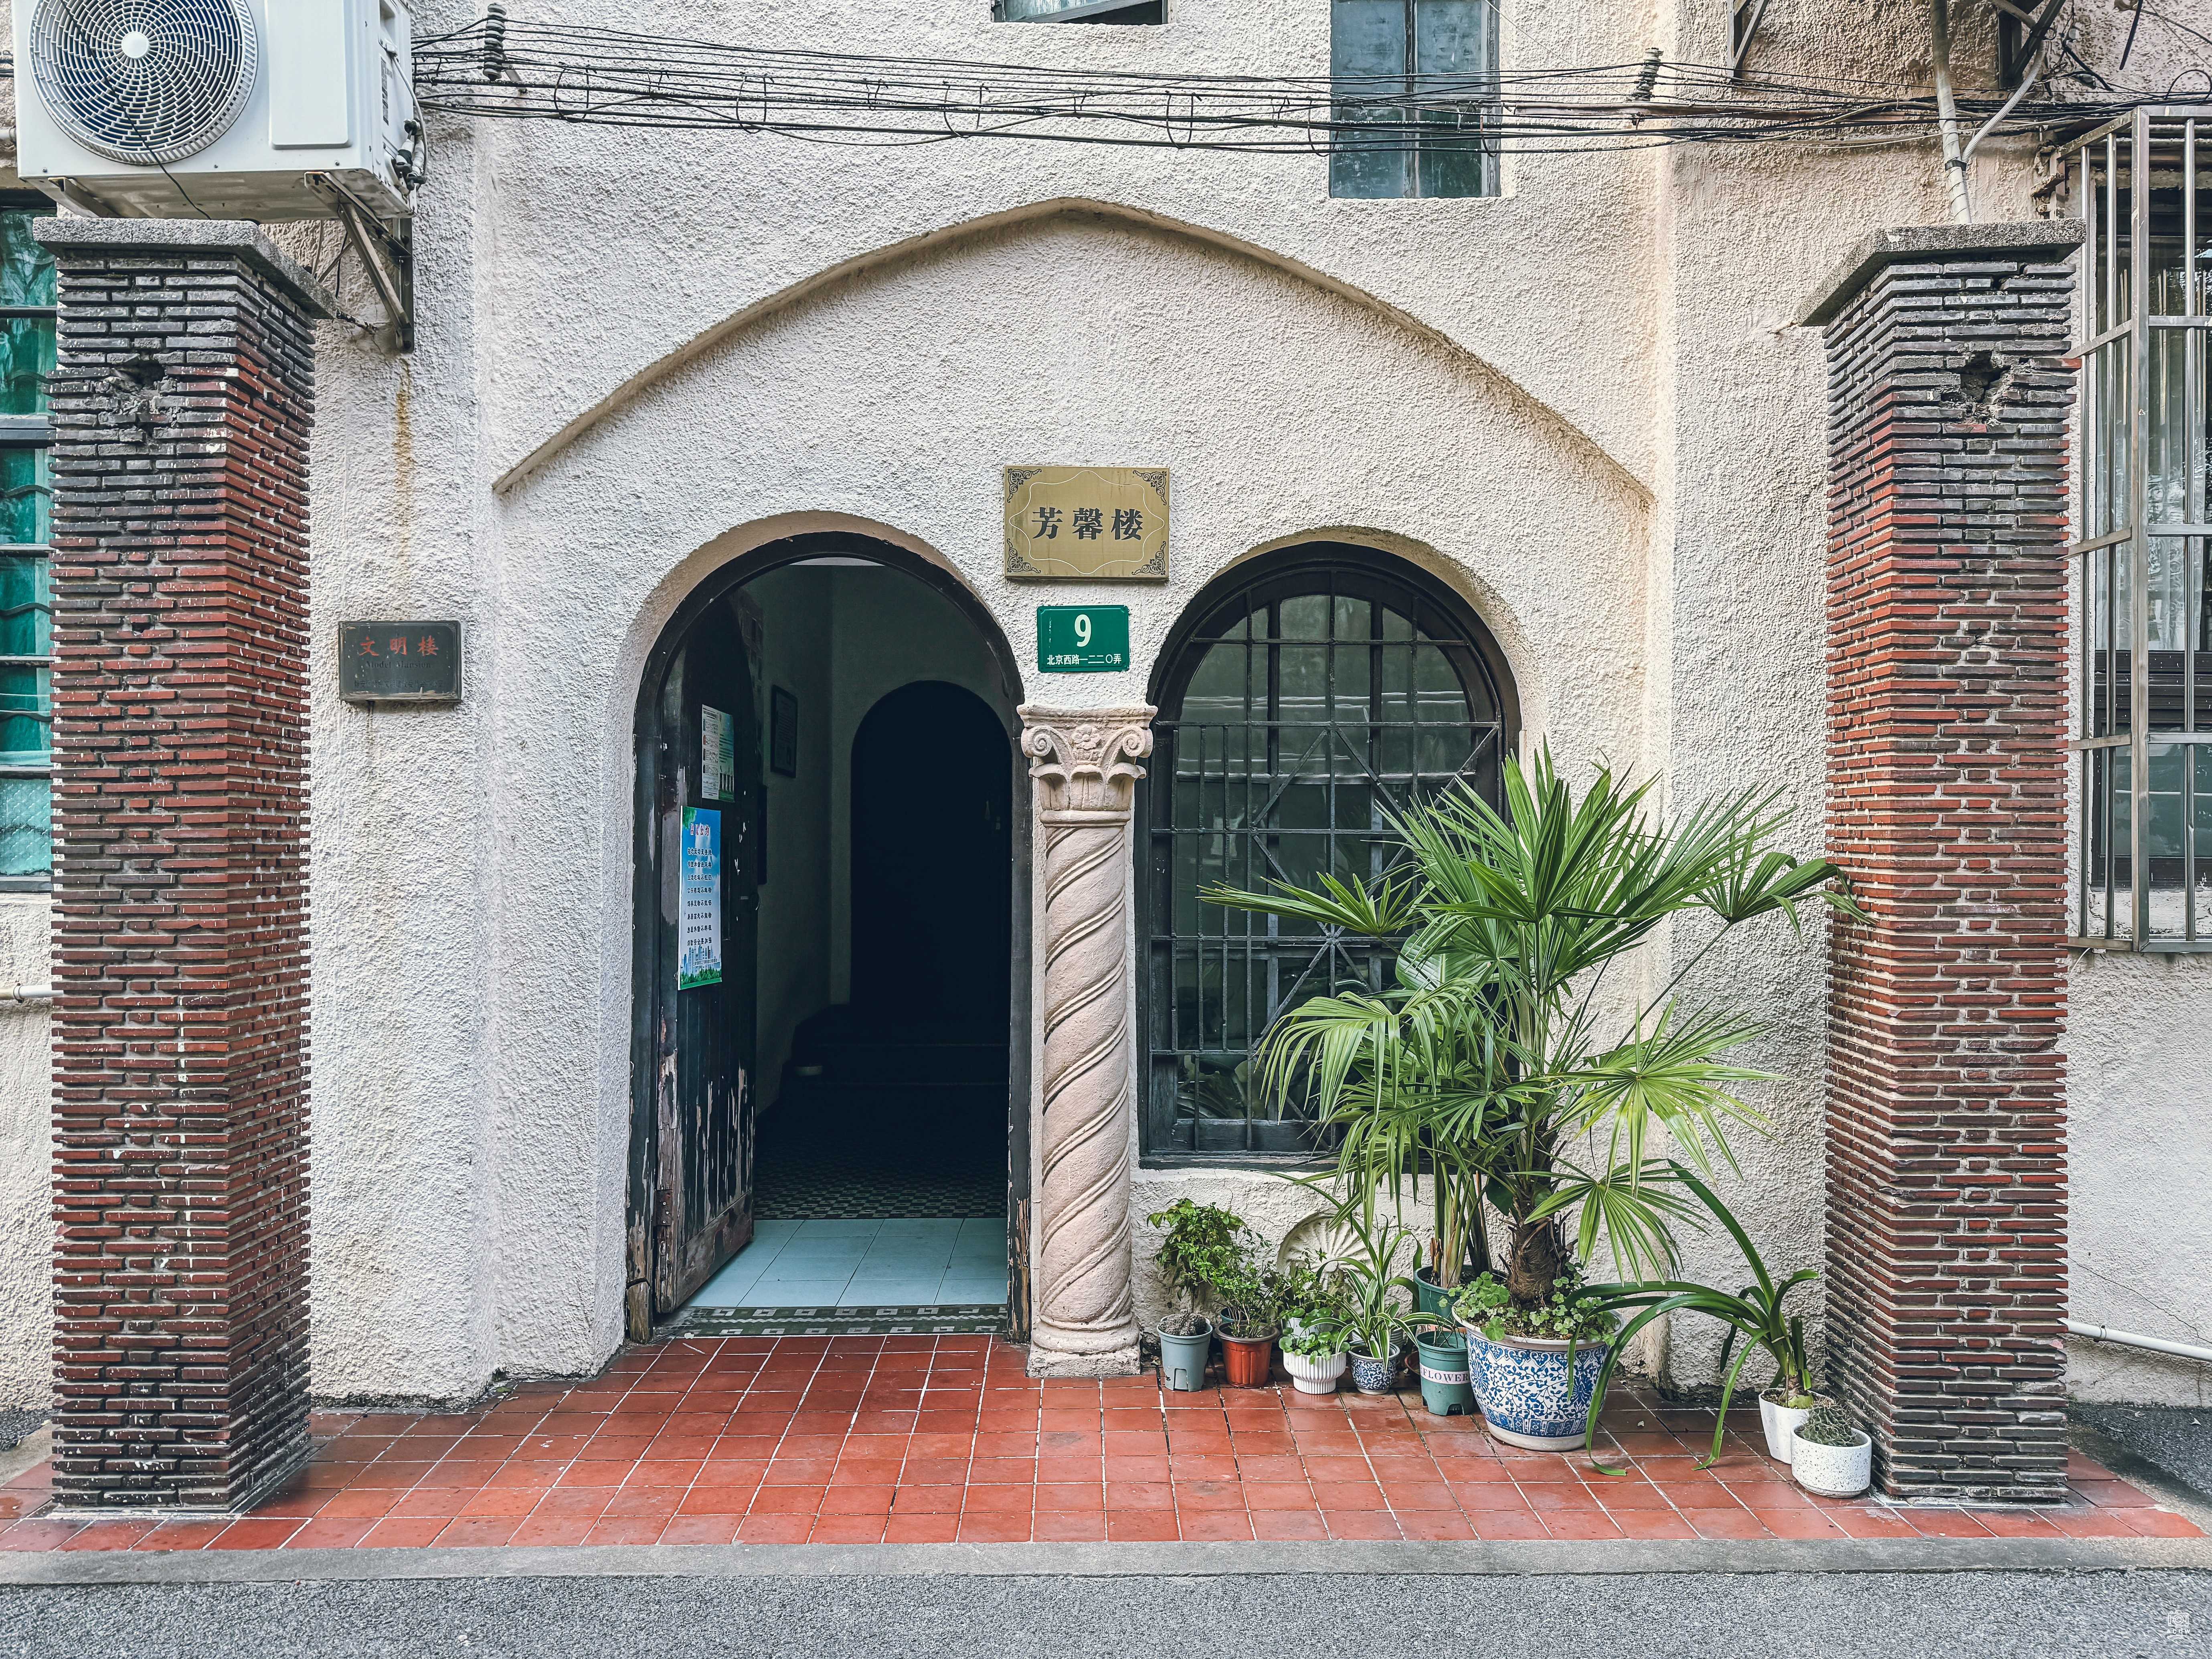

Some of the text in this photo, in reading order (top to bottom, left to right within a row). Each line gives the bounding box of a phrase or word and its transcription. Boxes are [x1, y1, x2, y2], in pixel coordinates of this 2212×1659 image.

[1032, 507, 1143, 540] 芳馨楼
[1075, 614, 1091, 647] 9
[360, 635, 439, 656] 文明楼
[1423, 1368, 1468, 1382] FLOWER
